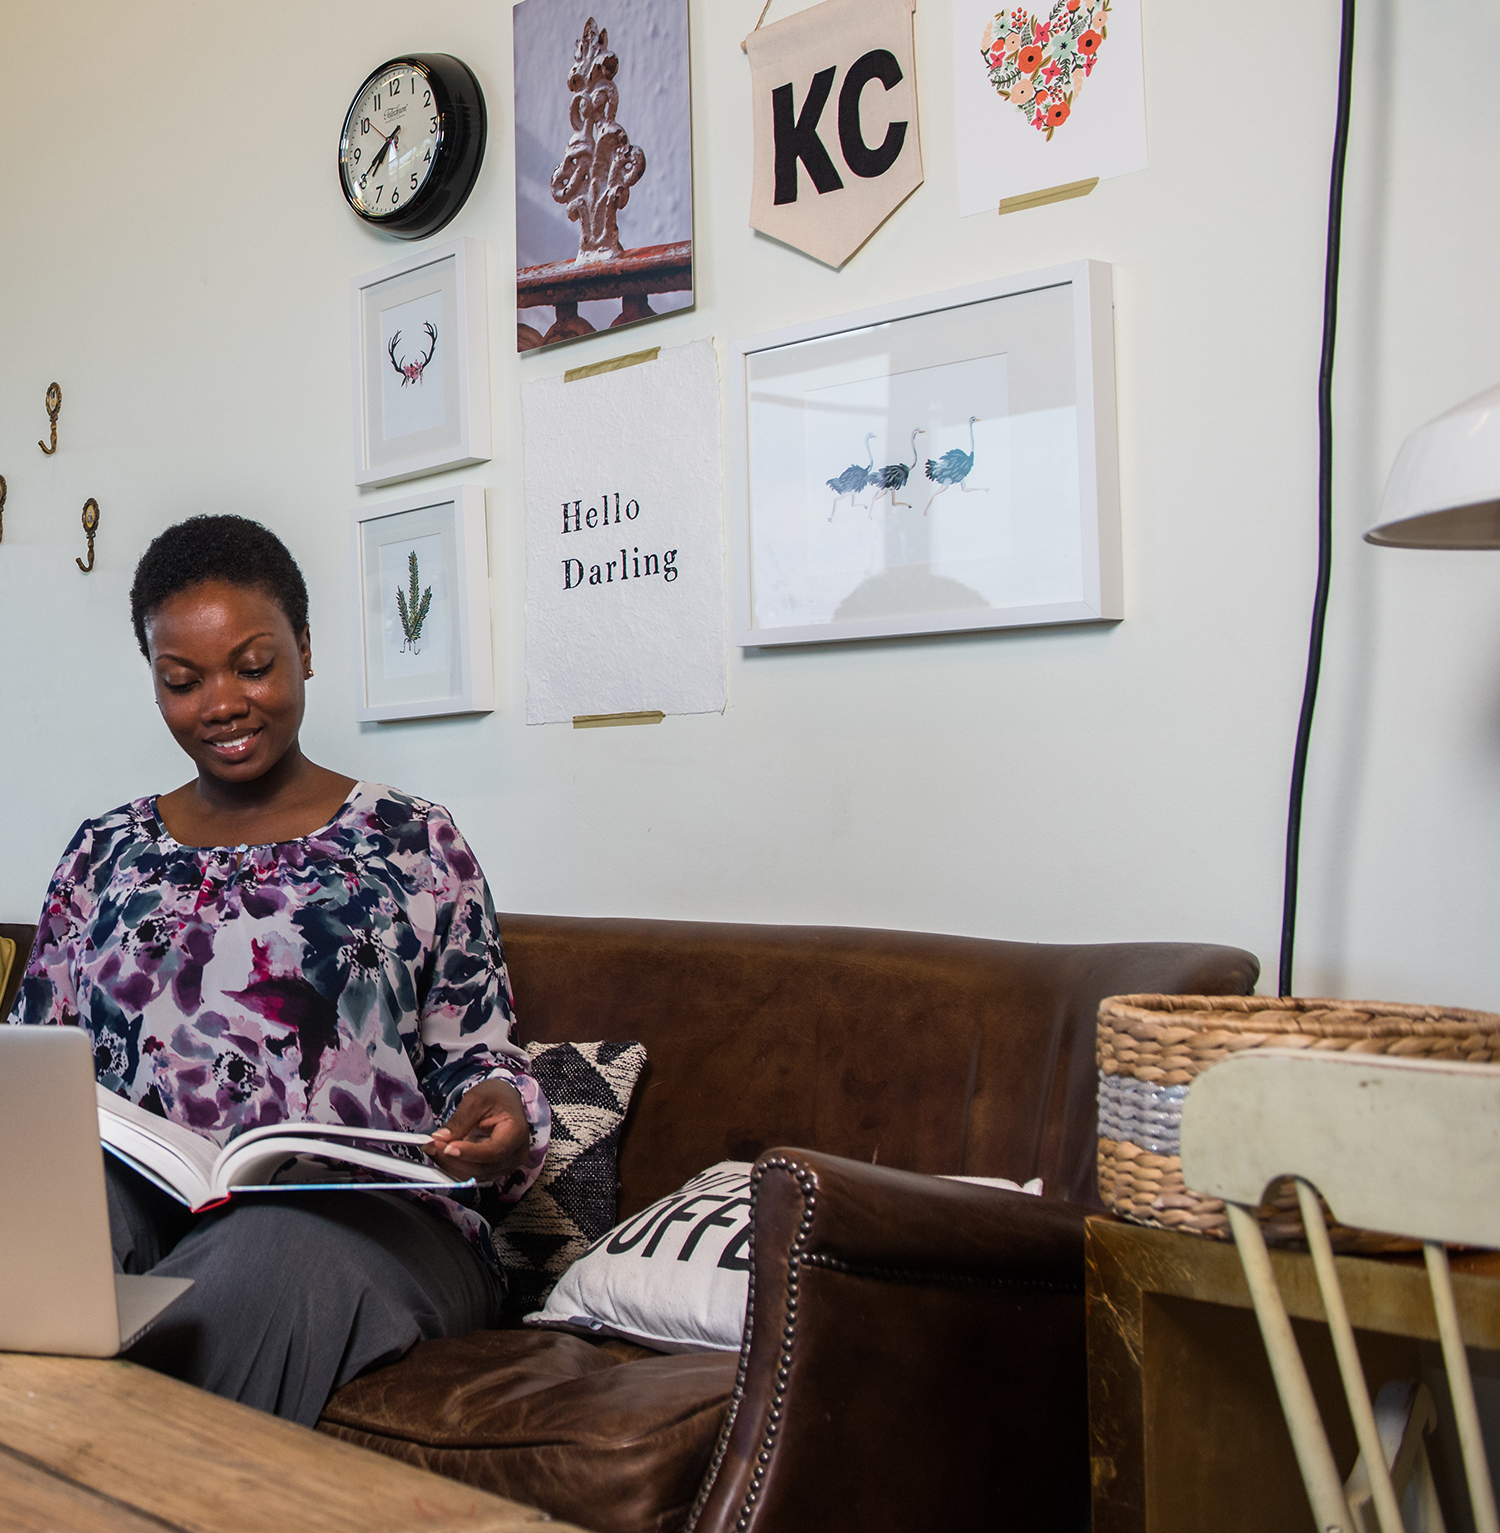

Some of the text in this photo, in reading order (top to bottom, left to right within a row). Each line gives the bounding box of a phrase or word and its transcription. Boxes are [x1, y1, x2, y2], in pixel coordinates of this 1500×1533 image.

[388, 78, 401, 97] 12
[411, 77, 415, 95] 1
[373, 93, 381, 112] 11
[423, 89, 431, 108] 2
[360, 117, 370, 136] 10
[429, 116, 438, 134] 3
[771, 48, 909, 206] KC
[354, 147, 362, 165] 9
[423, 147, 432, 164] 4
[359, 173, 367, 190] 8
[410, 172, 418, 190] 5
[376, 185, 384, 204] 7
[391, 186, 400, 204] 6
[560, 492, 640, 534] Hello
[561, 546, 679, 590] Darling
